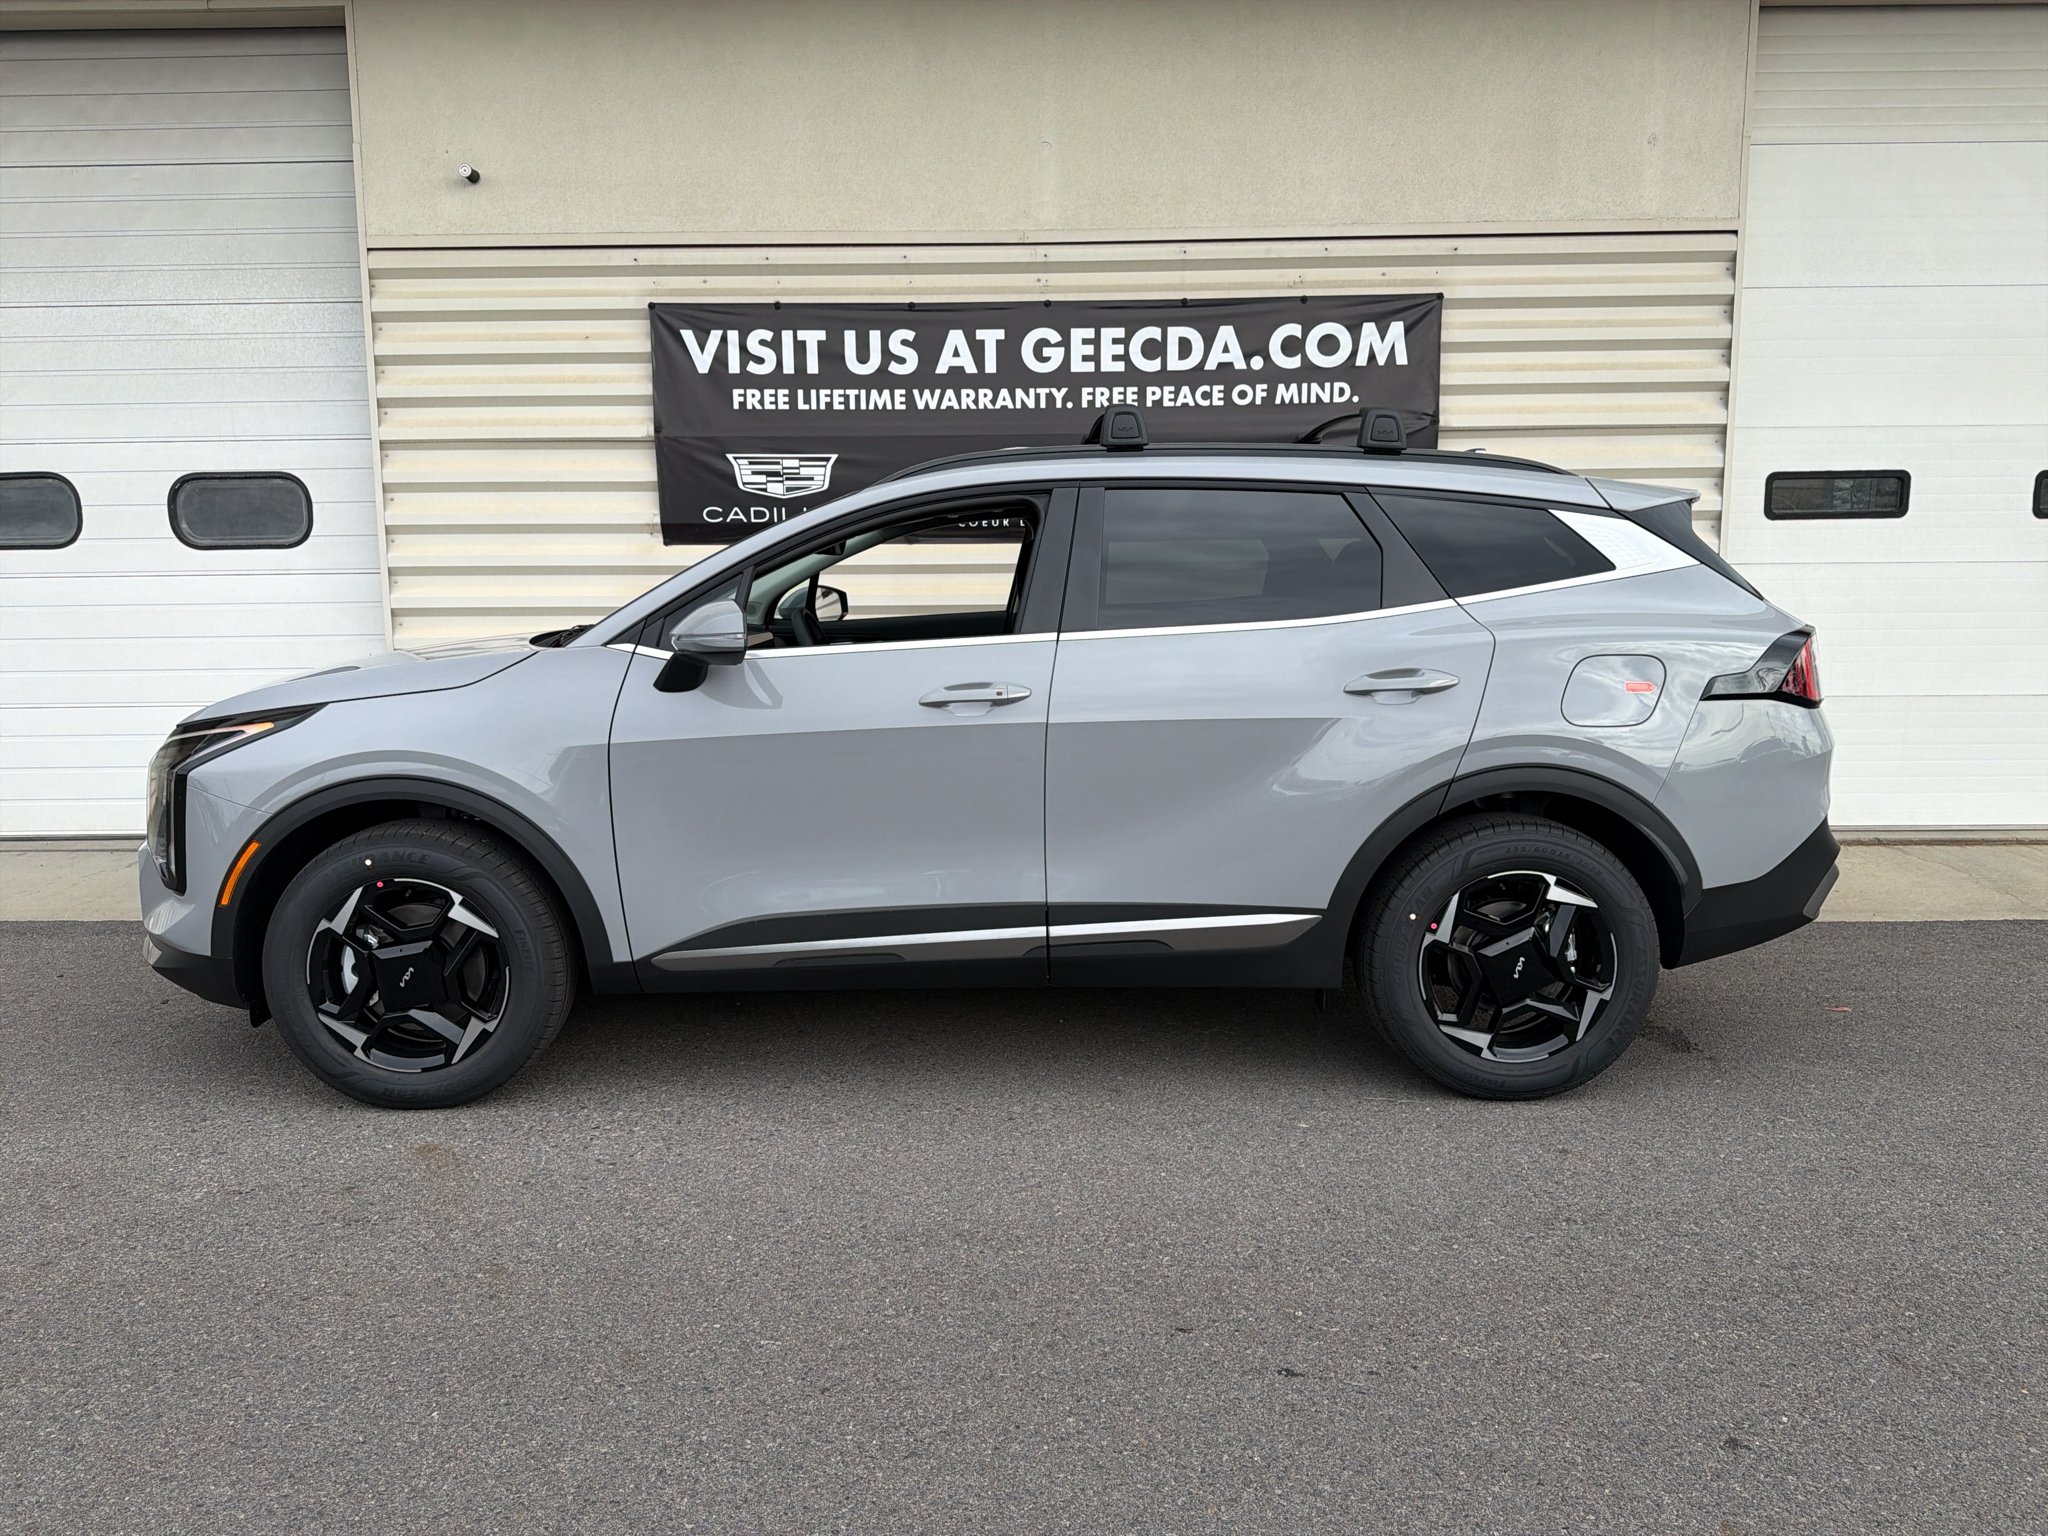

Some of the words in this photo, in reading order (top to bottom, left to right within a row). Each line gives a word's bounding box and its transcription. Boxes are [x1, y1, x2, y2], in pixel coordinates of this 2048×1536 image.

[679, 329, 827, 375] VISIT
[843, 329, 919, 376] US
[934, 328, 1006, 374] AT
[1020, 320, 1409, 374] GEECDA.COM
[732, 388, 790, 411] FREE
[797, 388, 907, 411] LIFETIME
[912, 387, 1074, 410] WARRANTY.
[1081, 386, 1139, 409] FREE
[1145, 384, 1226, 408] PEACE
[1231, 383, 1268, 406] OF
[1274, 381, 1360, 405] MIND.
